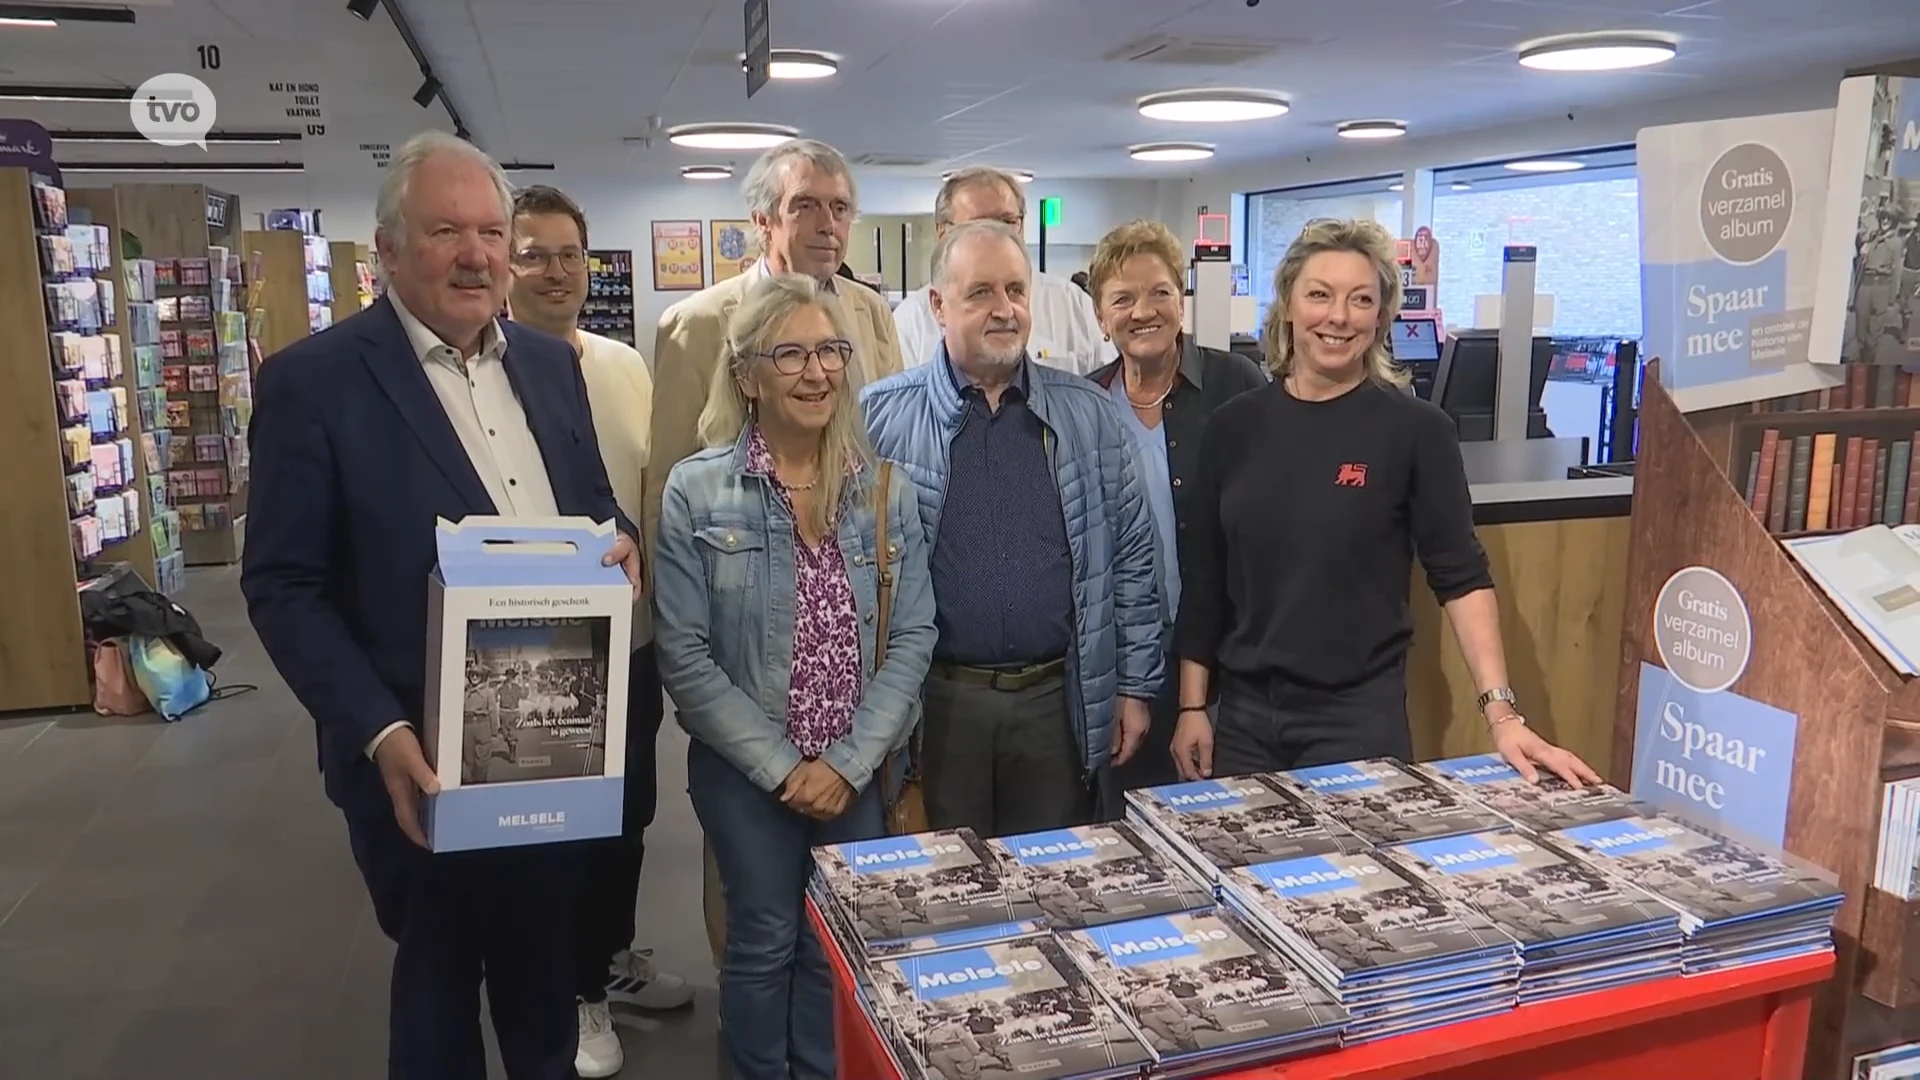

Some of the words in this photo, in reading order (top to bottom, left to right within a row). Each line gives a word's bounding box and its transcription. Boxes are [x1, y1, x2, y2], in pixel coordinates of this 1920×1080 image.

[197, 44, 221, 70] 10
[269, 82, 284, 93] KAT
[286, 83, 297, 93] EN
[298, 83, 319, 93] HOND
[294, 95, 320, 105] TOILET
[286, 108, 321, 117] VAATWAS
[1721, 167, 1774, 190] Gratis
[1708, 188, 1786, 217] verzamel
[1720, 217, 1774, 240] album
[1687, 284, 1769, 325] Spaar
[1687, 327, 1743, 358] mee
[1751, 326, 1764, 336] en
[489, 598, 507, 607] Een
[508, 597, 550, 607] historisch
[551, 597, 590, 608] geschenk
[1678, 589, 1728, 621] Gratis
[1663, 612, 1739, 649] verzamel
[1672, 639, 1725, 670] album
[1660, 701, 1766, 774] Spaar
[1309, 769, 1399, 788] Melsele
[1656, 759, 1726, 810] mee
[1170, 786, 1265, 806] Melsele
[498, 811, 565, 827] MELSELE
[855, 843, 962, 866] Melsele
[1019, 836, 1120, 858] Melsele
[1432, 842, 1536, 867] Melsele
[1271, 863, 1380, 889] Melsele
[1110, 929, 1228, 957] Melsele
[918, 959, 1044, 989] Melsele
